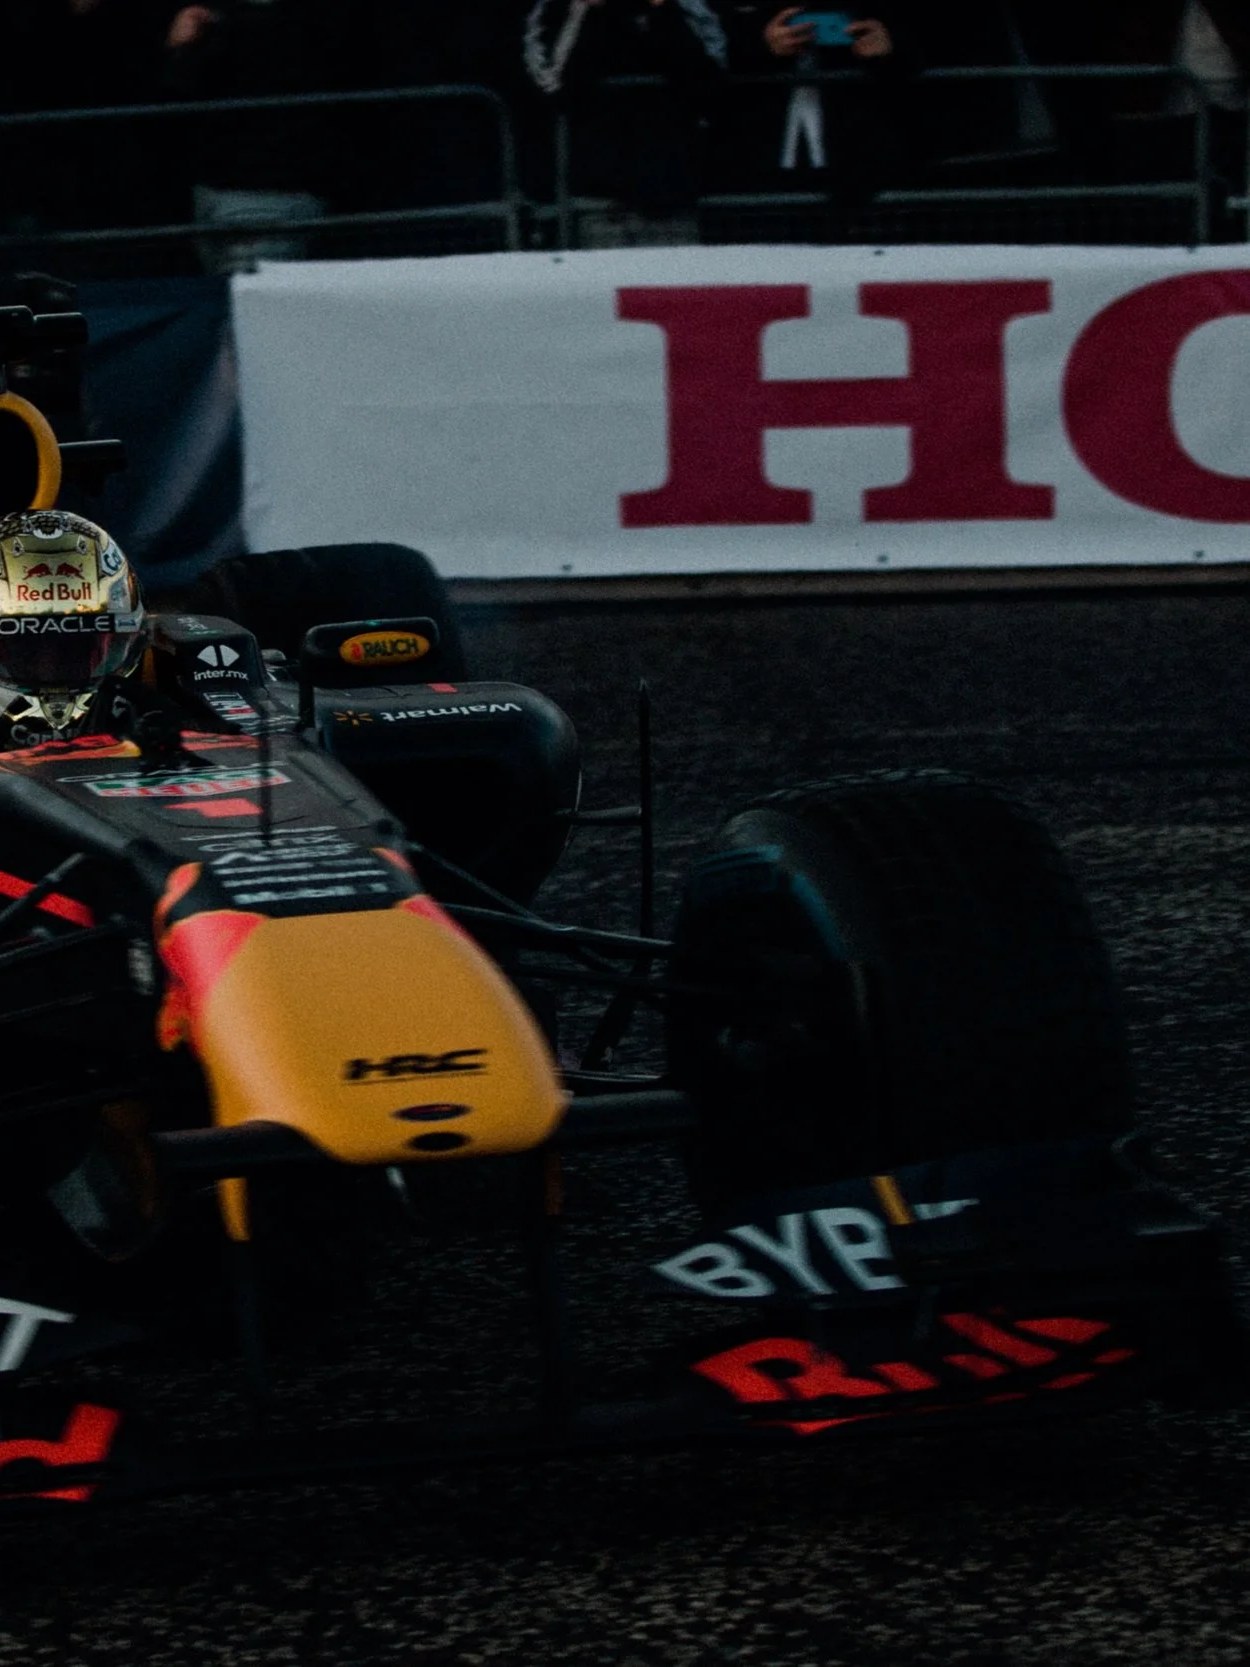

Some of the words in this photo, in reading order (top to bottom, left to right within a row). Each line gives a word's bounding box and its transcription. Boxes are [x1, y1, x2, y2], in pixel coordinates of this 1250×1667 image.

[617, 268, 1250, 528] HO
[18, 584, 54, 601] Red
[58, 581, 92, 601] Bull
[193, 668, 249, 681] inter.mx
[380, 702, 524, 723] Walmart
[346, 1048, 488, 1081] HRC
